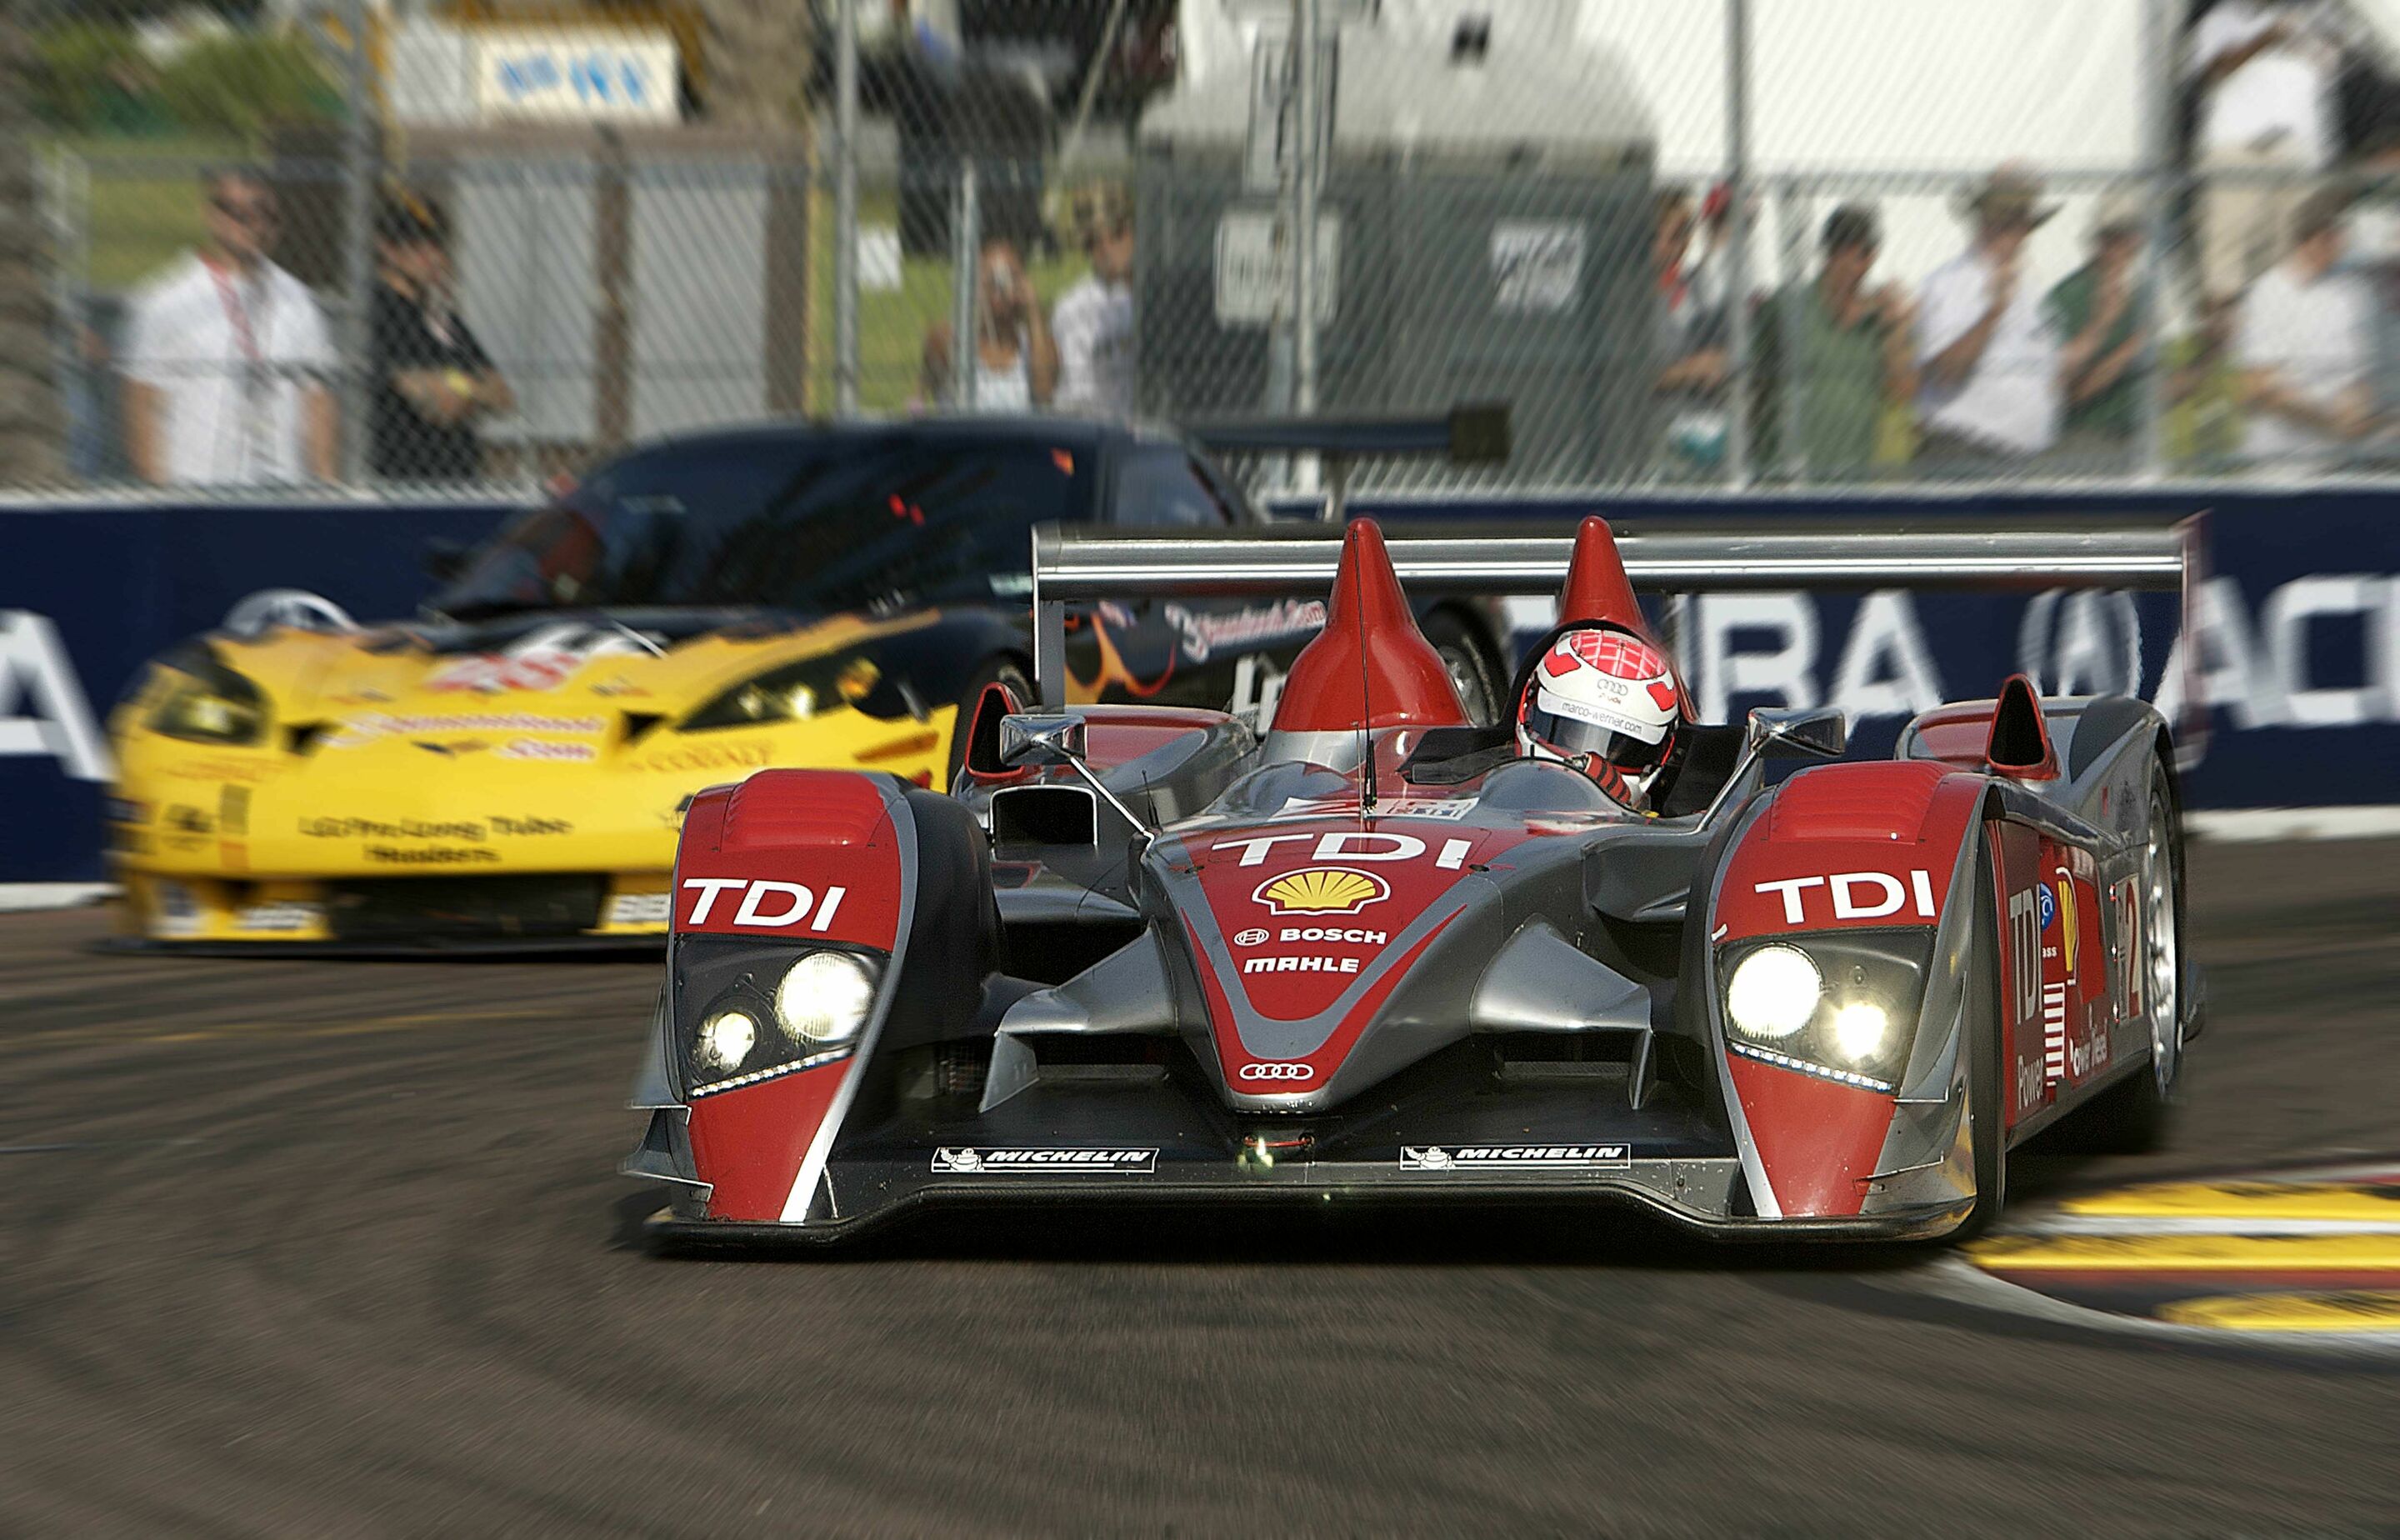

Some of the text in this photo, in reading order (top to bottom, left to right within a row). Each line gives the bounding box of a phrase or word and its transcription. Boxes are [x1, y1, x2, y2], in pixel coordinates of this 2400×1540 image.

[2152, 572, 2400, 731] AC
[1561, 702, 1642, 734] marco-werner.com
[1211, 832, 1472, 870] TDI
[682, 878, 847, 932] TDI
[1754, 869, 1936, 924] TDI
[1279, 928, 1387, 945] BOSCH
[2009, 883, 2042, 1026] TDI
[1243, 957, 1360, 973] MAHLE
[2018, 1054, 2043, 1110] Power
[986, 1150, 1151, 1162] MICHELIN
[1456, 1147, 1622, 1159] MICHELIN
